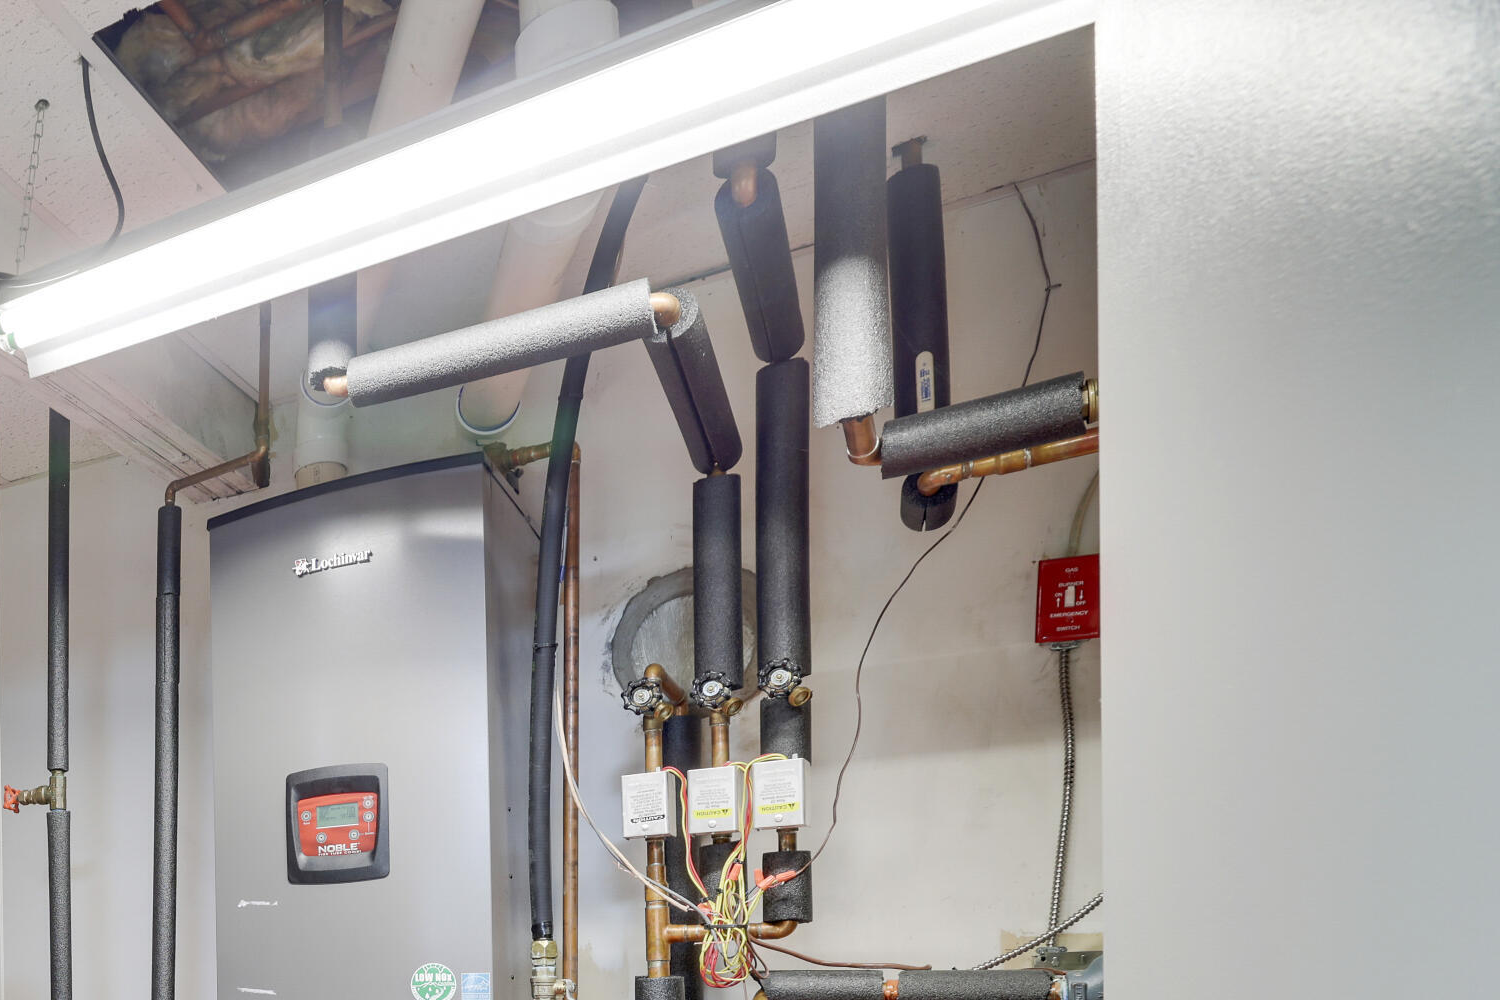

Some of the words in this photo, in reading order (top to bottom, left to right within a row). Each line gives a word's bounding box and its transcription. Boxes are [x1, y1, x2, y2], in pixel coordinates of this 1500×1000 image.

[311, 550, 372, 573] Lochinvar
[1058, 580, 1085, 588] BURNER
[1049, 610, 1089, 619] EMERGENCY
[318, 842, 359, 853] NOBLE
[415, 973, 433, 982] LOW
